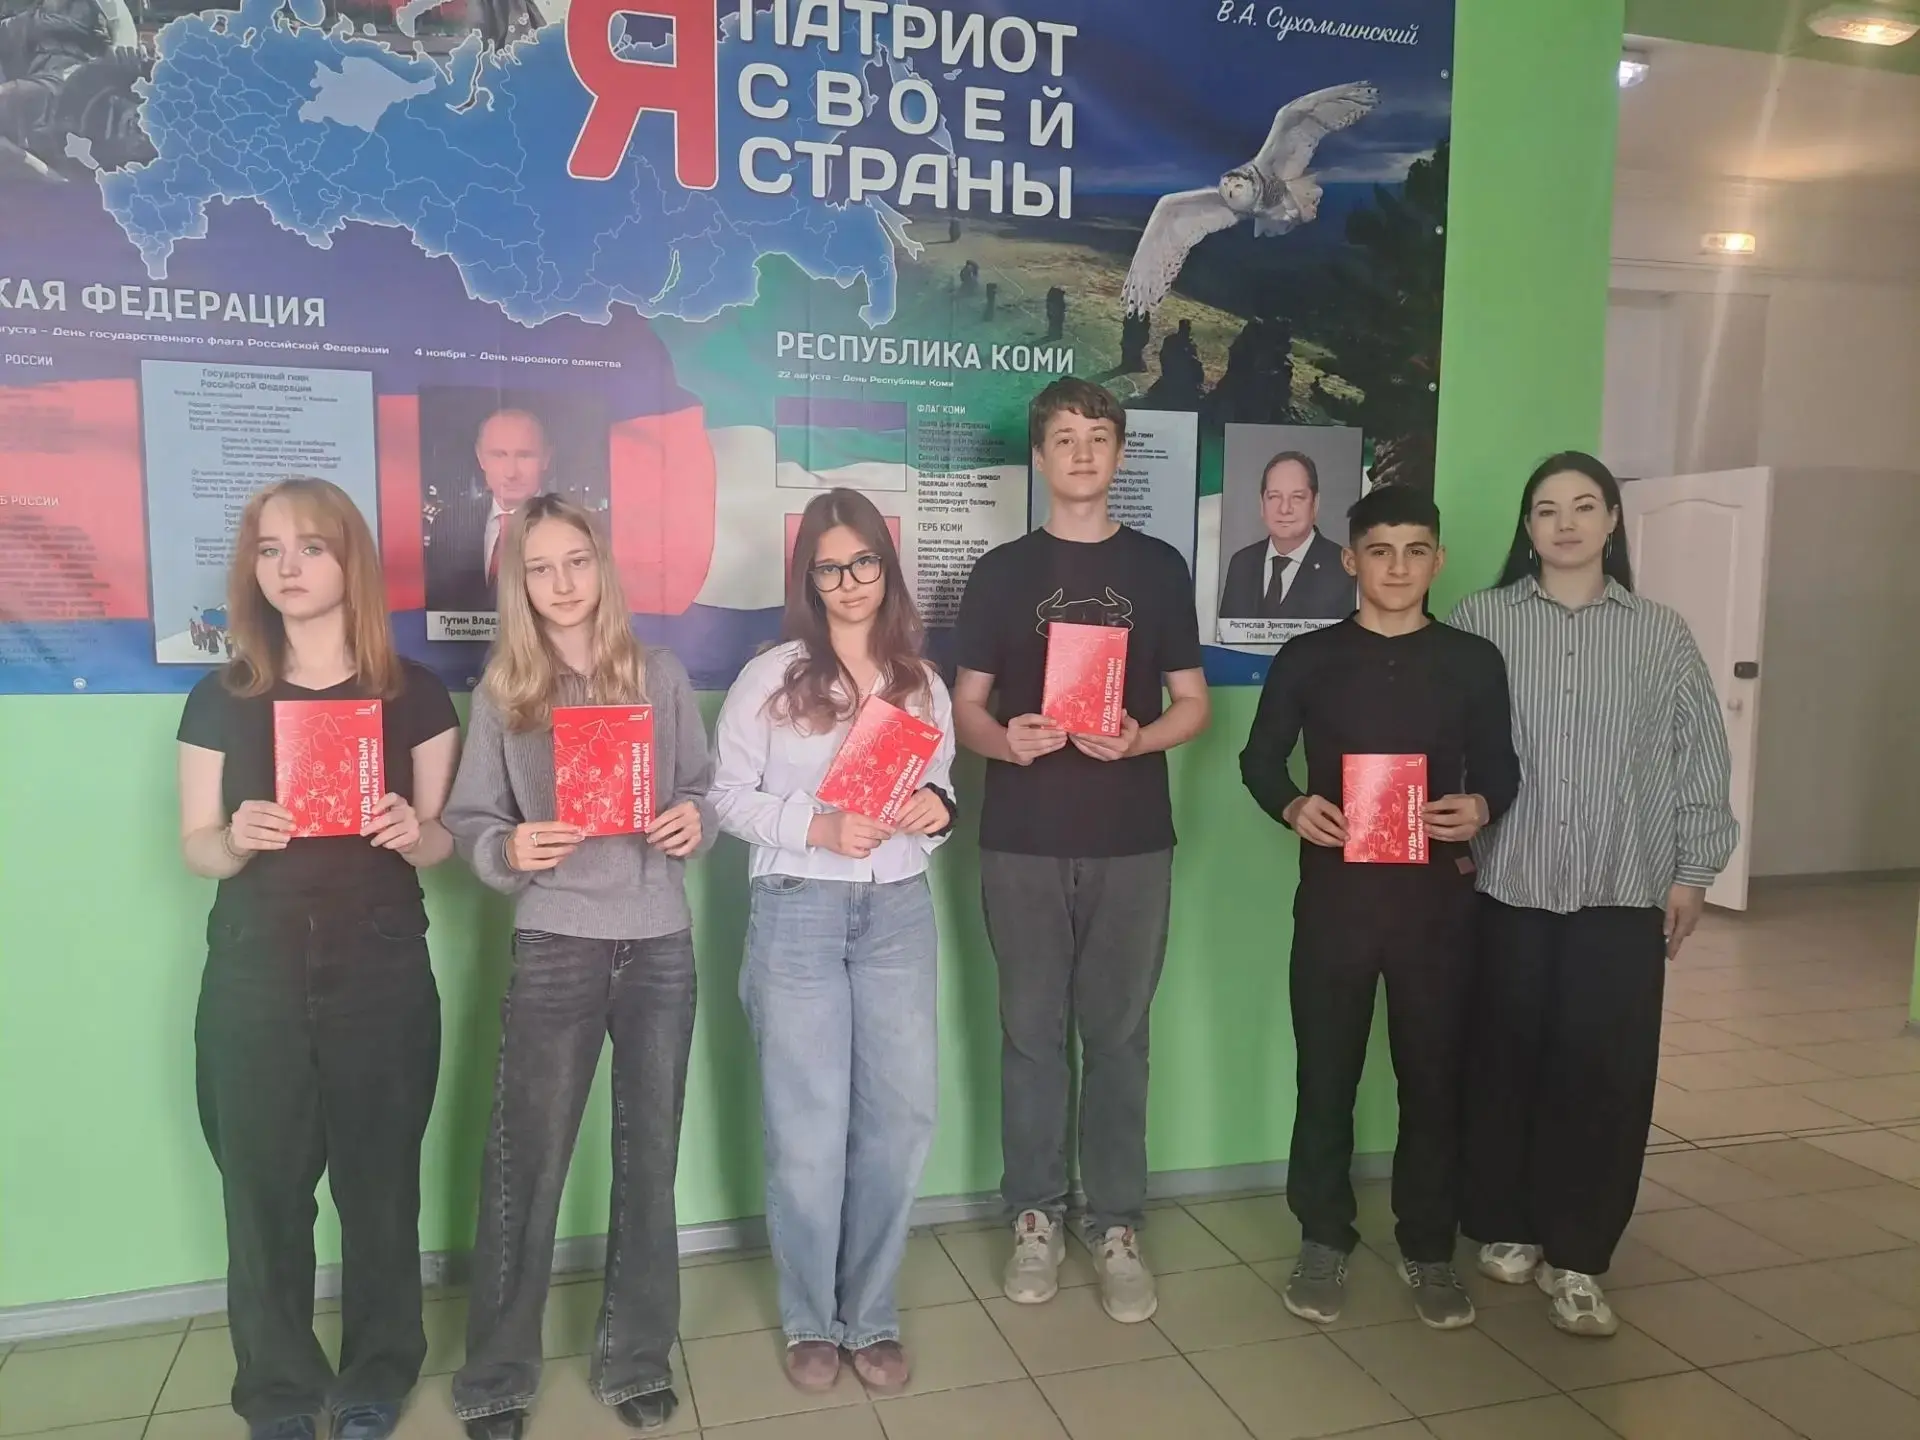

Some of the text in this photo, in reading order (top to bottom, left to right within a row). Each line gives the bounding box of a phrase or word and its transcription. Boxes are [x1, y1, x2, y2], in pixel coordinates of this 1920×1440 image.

[739, 0, 1077, 77] ПАТРИОТ
[1217, 0, 1419, 45] В.А. Сухомлинский
[564, 0, 719, 190] Я
[738, 62, 1073, 149] СВОЕЙ
[738, 136, 1072, 219] СТРАНЫ
[81, 283, 326, 328] ФЕДЕРАЦИЯ
[0, 325, 37, 335] густа
[52, 327, 86, 337] День
[89, 330, 203, 345] государственного
[207, 336, 244, 347] флага
[248, 338, 320, 350] Российской
[323, 342, 390, 354] Федерации
[5, 353, 53, 366] РОССИИ
[414, 348, 423, 356] 4
[426, 348, 466, 360] ноября
[479, 351, 508, 361] День
[511, 354, 569, 366] народного
[571, 358, 622, 369] единства
[776, 331, 1075, 375] РЕСПУБЛИКА КОМИ
[777, 370, 791, 378] 22
[842, 375, 867, 383] День
[929, 378, 954, 388] Коми
[917, 404, 966, 415] ФЛАГ КОМИ
[918, 522, 963, 533] ГЕРБ КОМИ
[440, 616, 469, 627] Путин
[445, 628, 490, 637] Президент
[1230, 620, 1265, 630] Ростислав
[1101, 657, 1115, 732] БУДЬ ПЕРВЫМ
[358, 737, 369, 794] ПЕРВЫМ
[642, 743, 650, 778] ПЕРВЫХ
[631, 742, 644, 829] БУДЬ ПЕРВЫМ
[880, 754, 920, 823] УДЬ ПЕРВЫМ
[1407, 784, 1418, 860] БУДЬ ПЕРВЫМ
